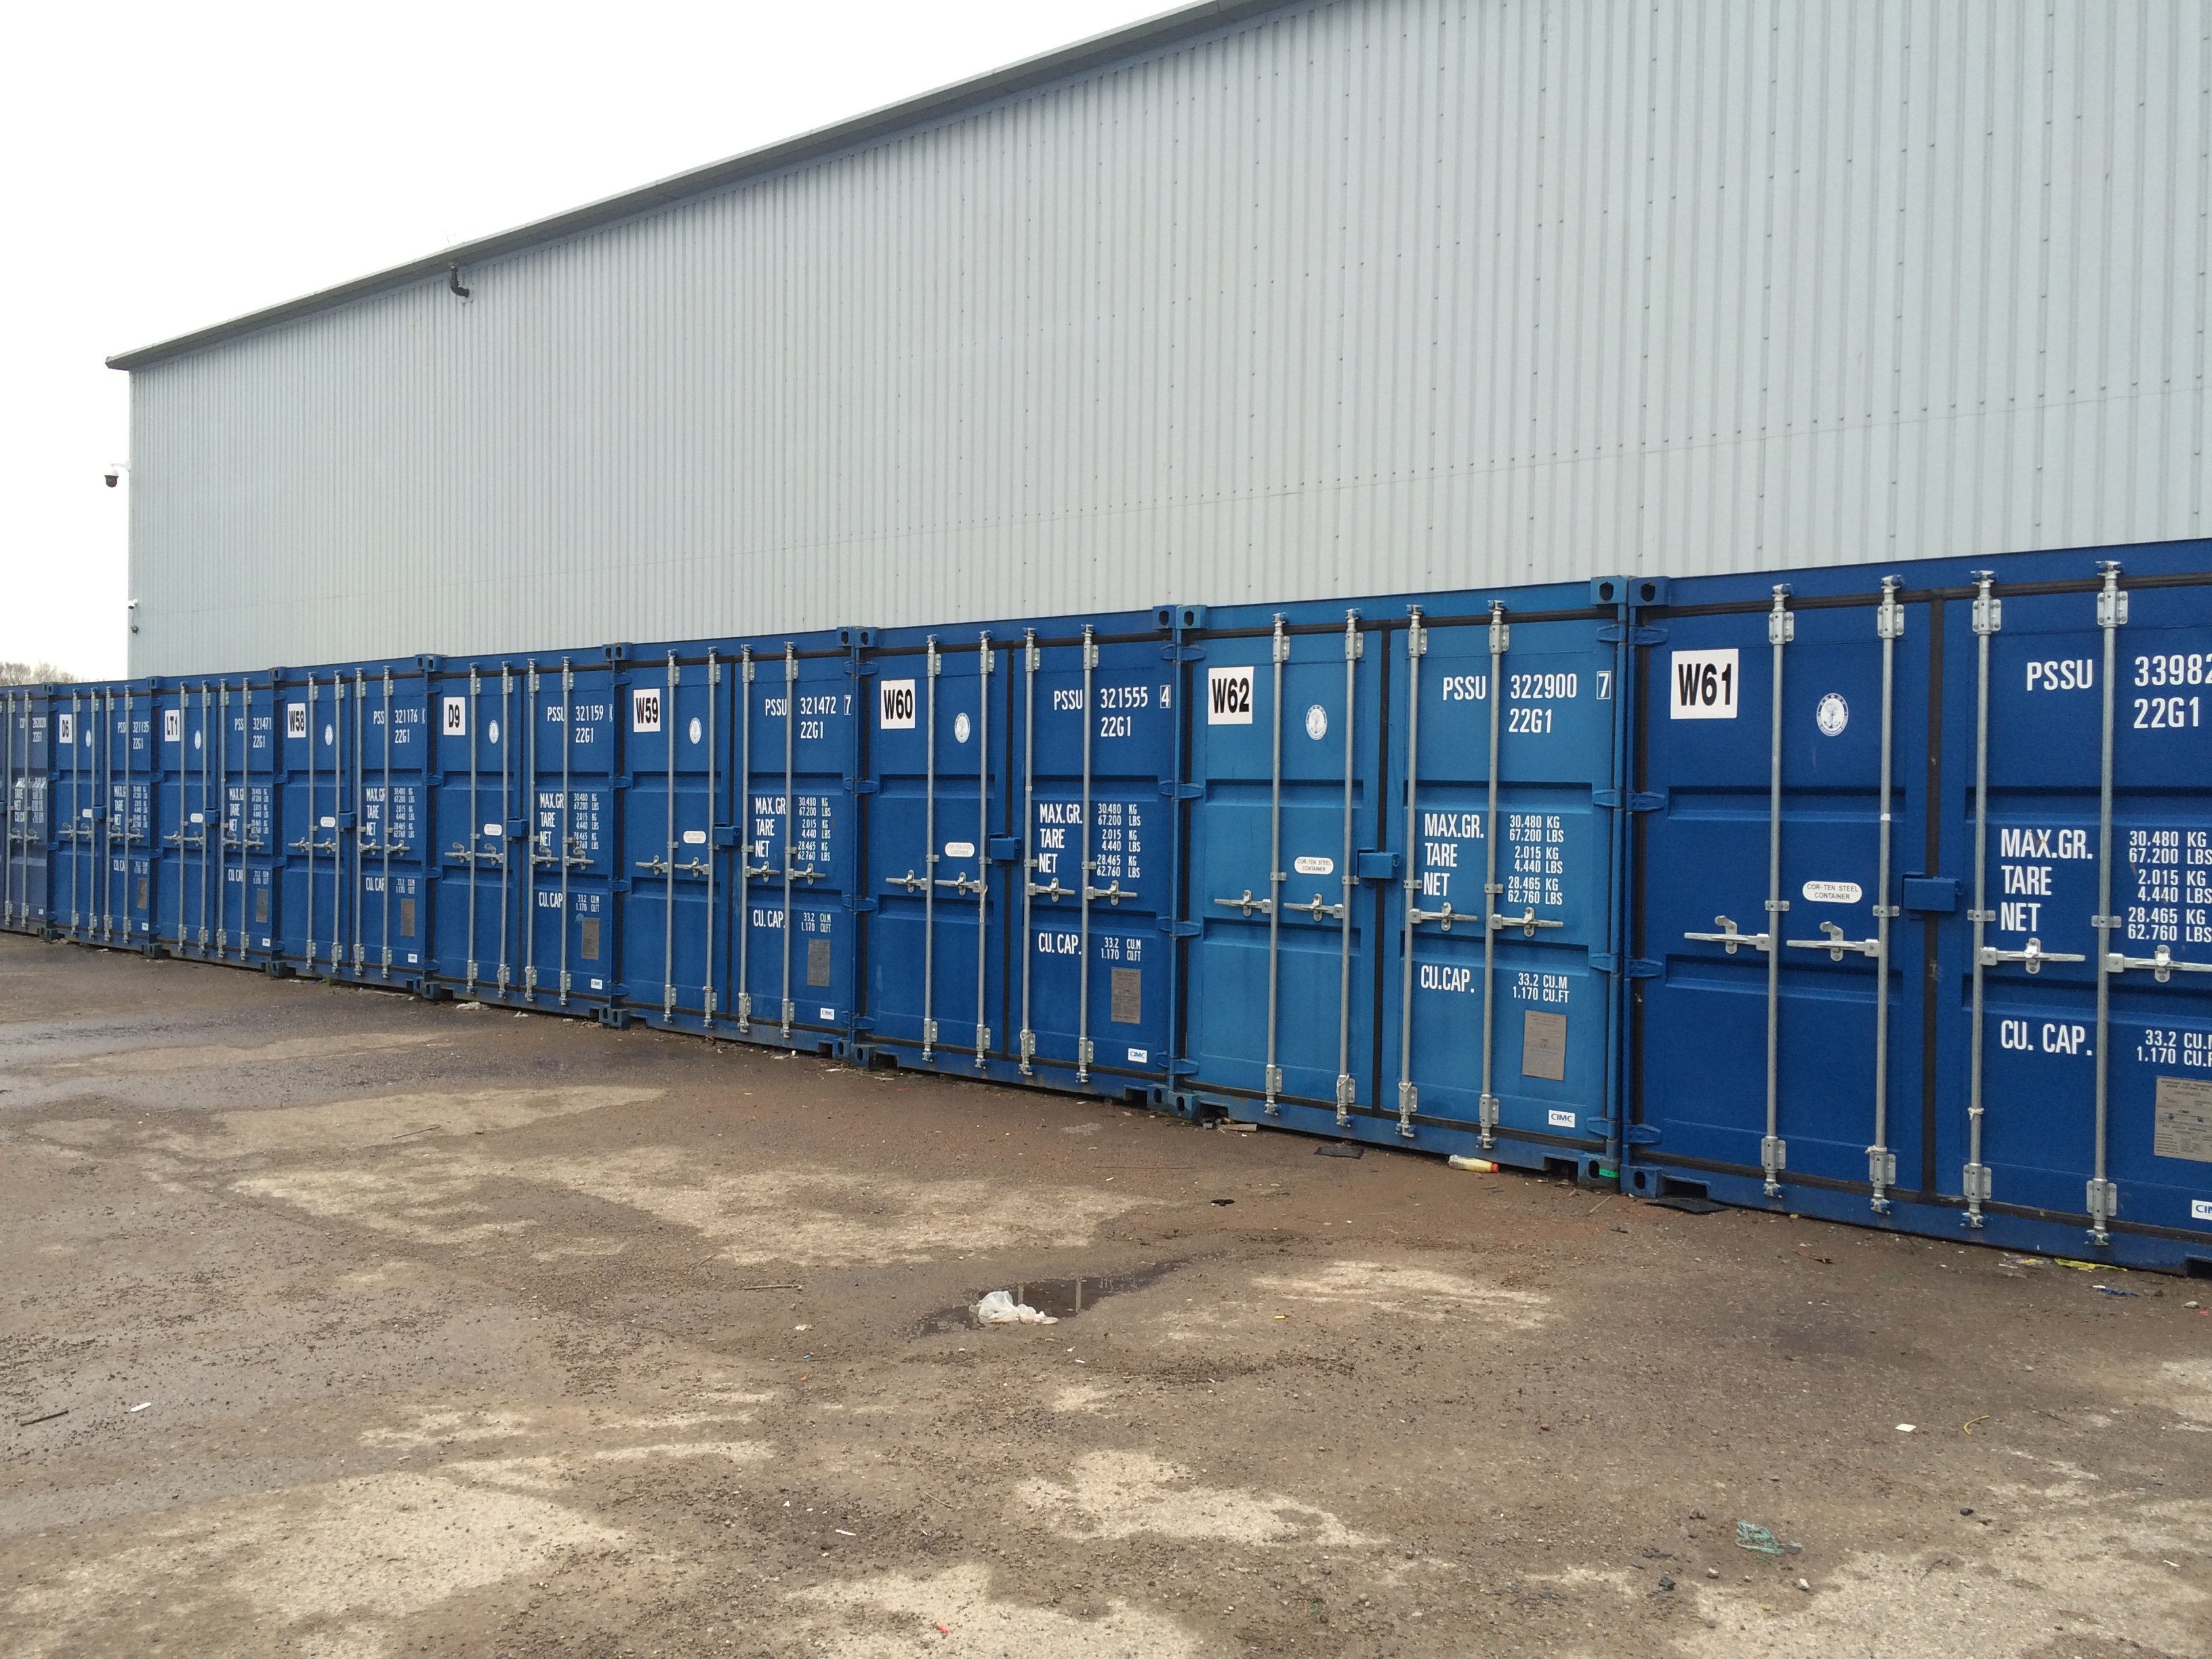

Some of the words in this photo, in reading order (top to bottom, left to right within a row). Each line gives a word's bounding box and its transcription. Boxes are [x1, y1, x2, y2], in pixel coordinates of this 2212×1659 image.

[2027, 659, 2093, 691] PSSU
[1443, 676, 1486, 701] PSSU
[1511, 673, 1577, 699] 322900
[1597, 672, 1610, 698] 7
[1678, 663, 1732, 706] W61
[883, 689, 913, 720] W60
[1054, 689, 1083, 711] PSSU
[1100, 687, 1148, 709] 321555
[1161, 686, 1170, 707] 4
[1212, 678, 1250, 714] W62
[575, 705, 604, 722] 321159
[636, 697, 658, 724] W59
[765, 699, 787, 716] PSSU
[800, 696, 836, 715] 321472
[845, 696, 851, 714] 7
[2134, 697, 2199, 729] 22G1
[289, 710, 304, 732] W58
[373, 710, 384, 724] PSS
[395, 709, 417, 724] 321176
[449, 704, 459, 728] D9
[1509, 708, 1552, 733] 22G1
[62, 720, 69, 737] D6
[167, 716, 178, 735] LT1
[800, 721, 823, 739] 22G1
[1101, 716, 1131, 737] 22G1
[395, 729, 409, 743] 22G1
[575, 727, 594, 743] 22G1
[821, 798, 828, 806] KG
[1128, 804, 1137, 815] KG
[540, 811, 556, 827] TARE
[821, 807, 831, 817] LBS
[1128, 815, 1141, 826] LBS
[756, 819, 775, 836] TARE
[822, 819, 828, 829] KG
[1425, 813, 1484, 838] MAX.GR.
[1547, 815, 1560, 829] KG
[539, 831, 552, 846] NET
[821, 830, 831, 839] LBS
[1040, 828, 1065, 848] TARE
[1128, 830, 1137, 840] KG
[1547, 830, 1564, 842] LBS
[2187, 832, 2207, 847] KG
[755, 840, 770, 857] NET
[1128, 841, 1141, 853] LBS
[2001, 829, 2093, 859] MAX.GR.
[1128, 855, 1137, 867] KG
[1425, 842, 1458, 867] TARE
[1546, 846, 1559, 860] KG
[2187, 848, 2212, 865] LBS
[1039, 853, 1058, 874] NET
[1546, 861, 1563, 874] LBS
[1128, 867, 1141, 878] LBS
[2001, 865, 2052, 896] TARE
[2186, 870, 2206, 886] KG
[1423, 872, 1450, 896] NET
[1545, 878, 1559, 891] KG
[1545, 892, 1563, 905] LBS
[1815, 892, 1850, 900] CONTAINER
[2186, 887, 2212, 904] LBS
[2001, 902, 2041, 932] NET
[2186, 909, 2206, 925] KG
[1104, 937, 1119, 948] 33.2
[2186, 926, 2212, 943] LBS
[1518, 972, 1538, 987] 33.2
[1543, 975, 1568, 989] CU.M
[1543, 989, 1570, 1003] CU.FT
[2145, 1029, 2177, 1047] 33.2
[1551, 1113, 1573, 1123] CIMC
